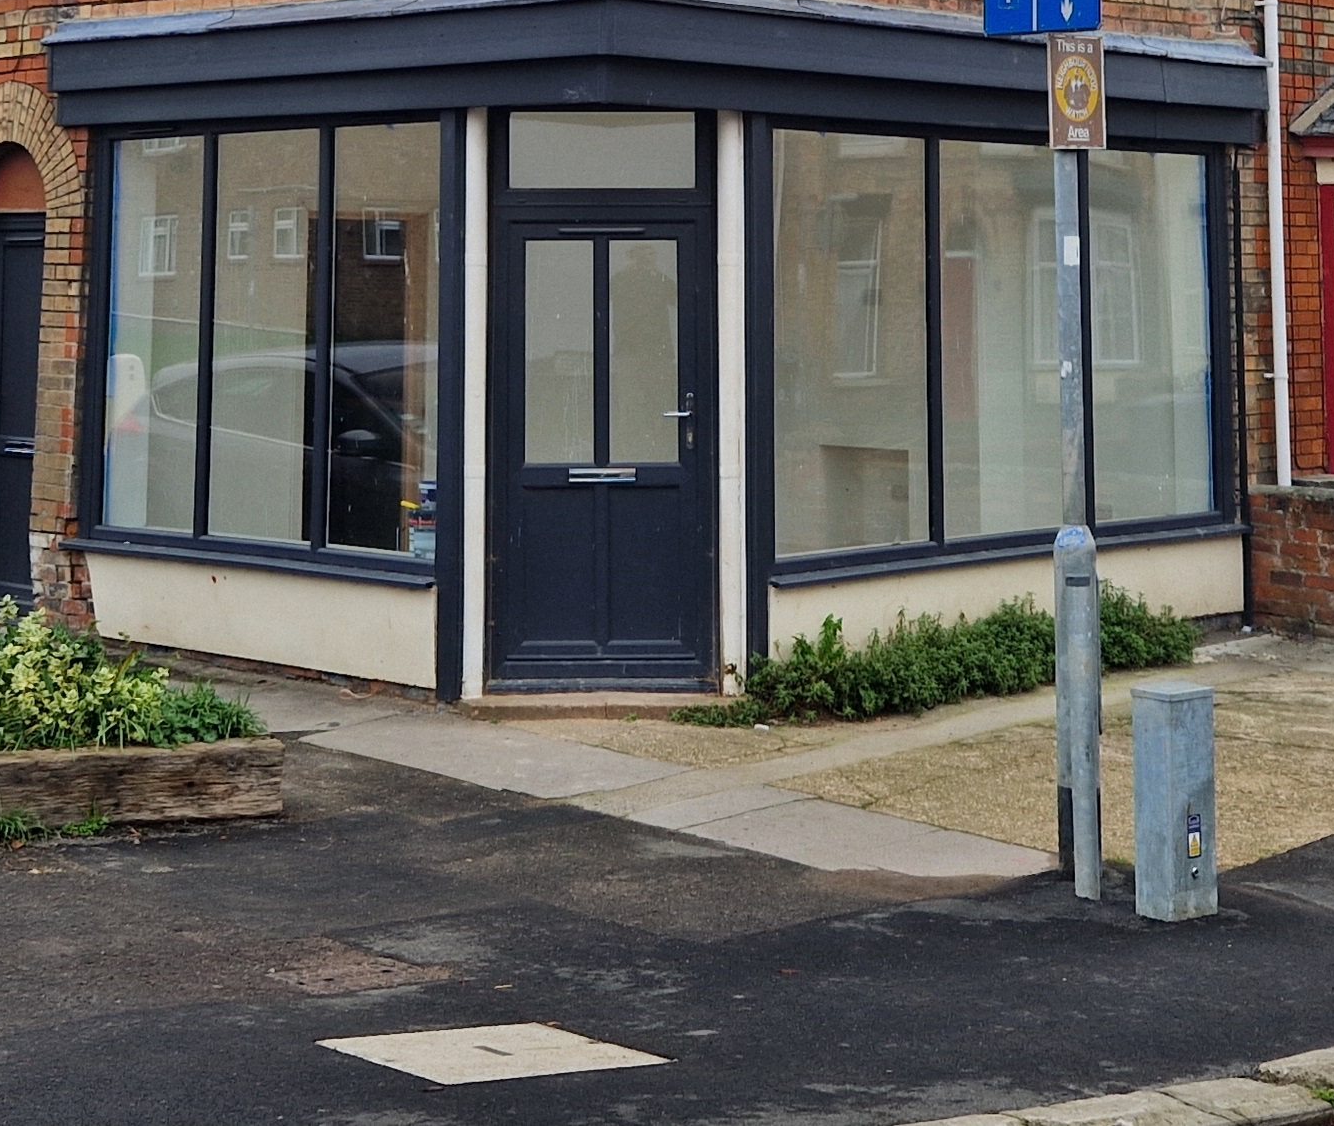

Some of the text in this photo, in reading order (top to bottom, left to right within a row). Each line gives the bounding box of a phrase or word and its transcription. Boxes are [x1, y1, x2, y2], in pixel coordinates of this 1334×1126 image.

[1056, 39, 1093, 53] This is a
[1067, 125, 1090, 139] Area
